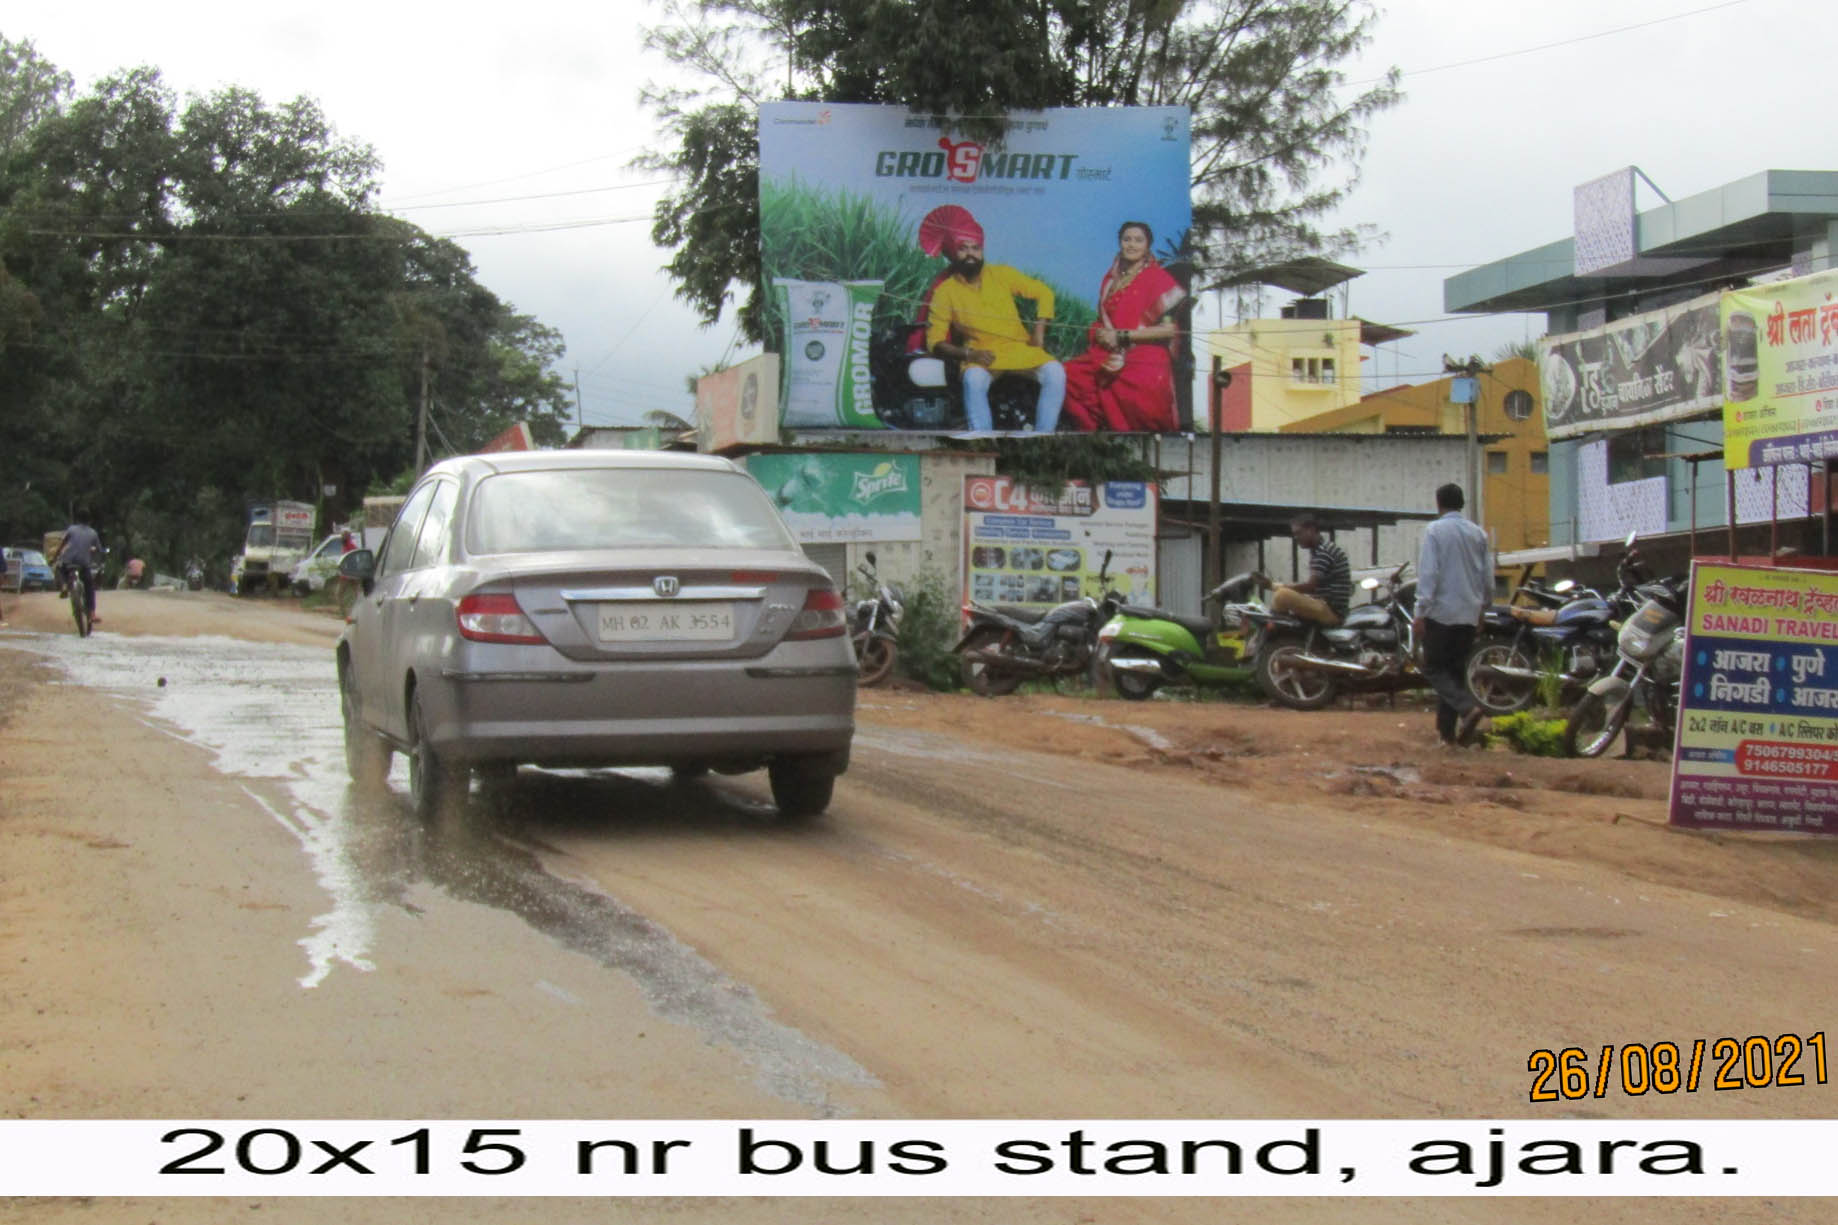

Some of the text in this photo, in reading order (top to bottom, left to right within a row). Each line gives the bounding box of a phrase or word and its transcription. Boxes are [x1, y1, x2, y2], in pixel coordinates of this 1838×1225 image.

[857, 472, 902, 496] Sprite
[659, 616, 681, 630] AK
[1703, 614, 1769, 636] SANADI
[1713, 648, 1825, 683] आजरा पुणे
[1710, 676, 1771, 705] निगडी
